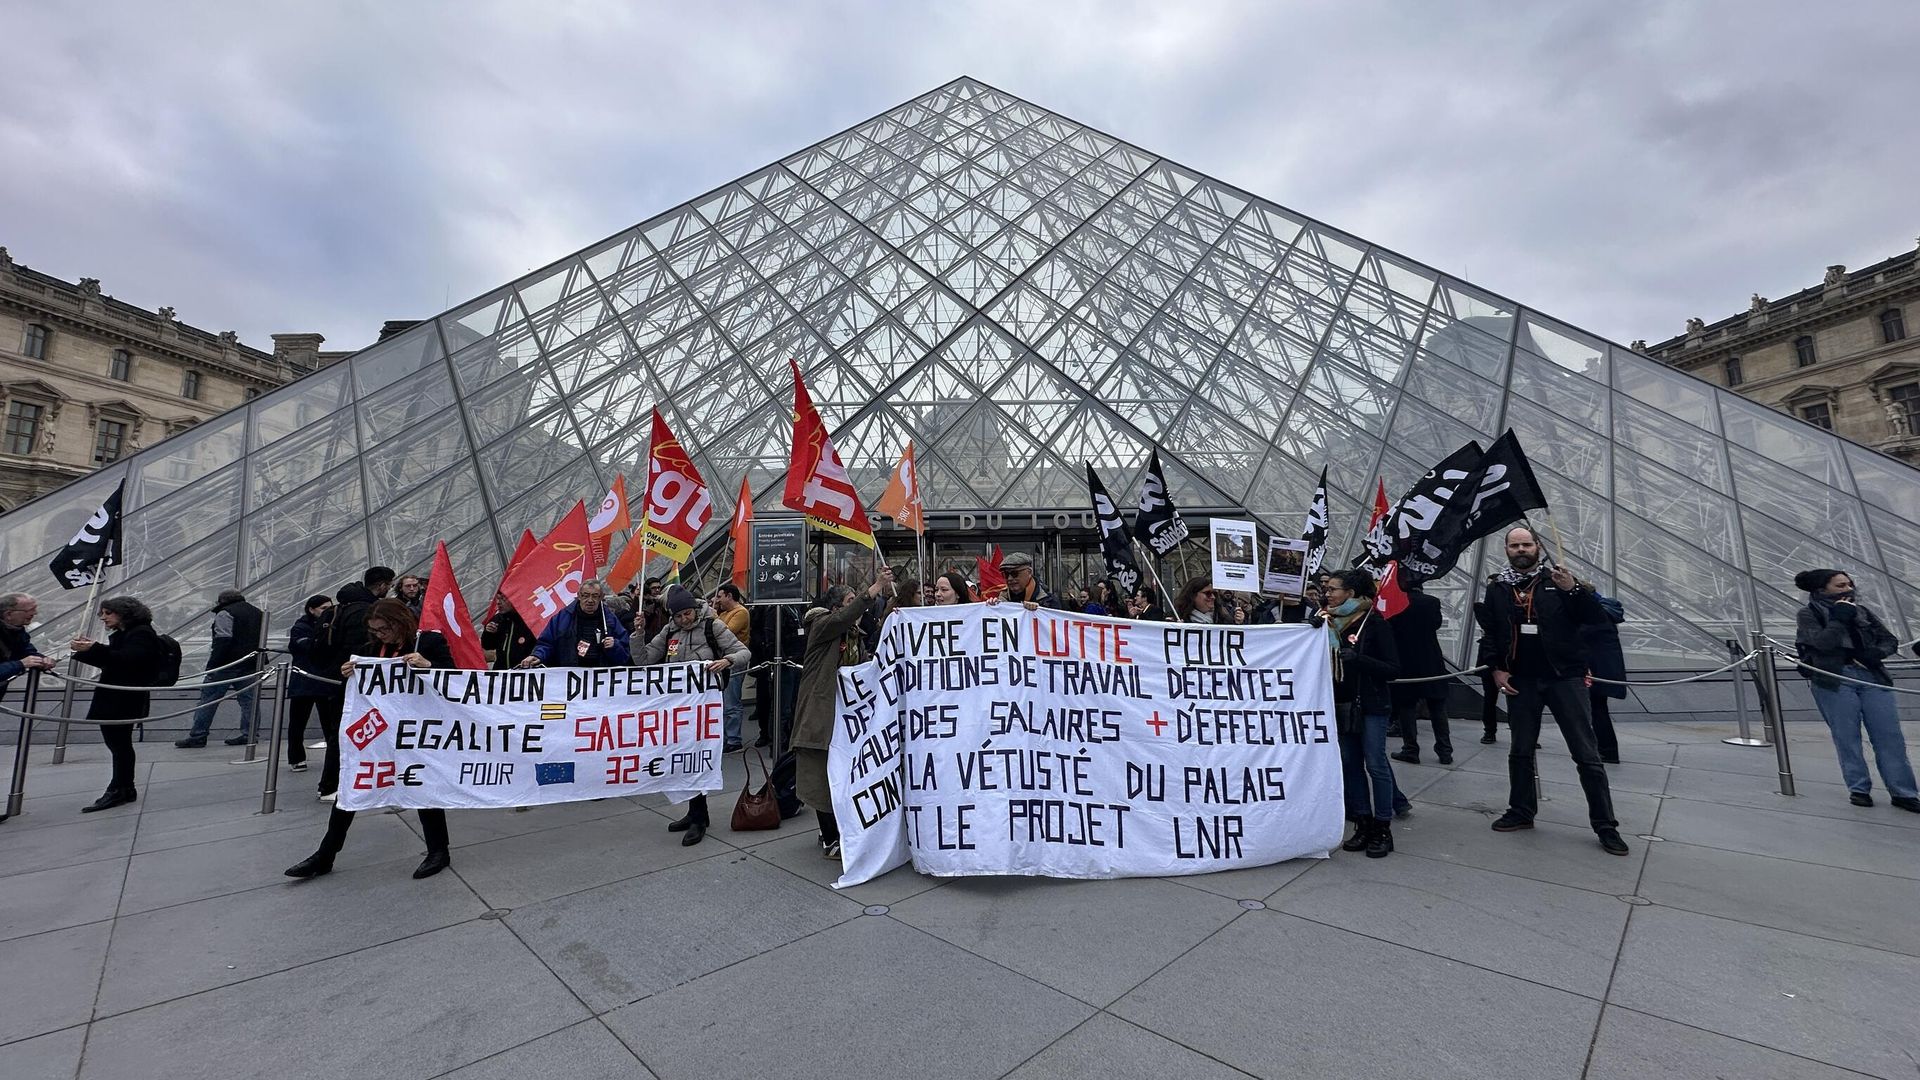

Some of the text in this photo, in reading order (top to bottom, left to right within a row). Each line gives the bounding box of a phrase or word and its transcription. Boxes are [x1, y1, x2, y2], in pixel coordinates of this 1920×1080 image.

[959, 513, 1098, 531] DU LOU
[838, 670, 873, 708] LE
[982, 617, 1019, 653] EN
[1032, 617, 1132, 664] LUTTE
[1163, 628, 1247, 666] POUR
[1008, 655, 1038, 688] DE
[1043, 659, 1152, 700] TRAVAIL
[395, 703, 722, 753] EGALITE SACRIFIE
[910, 705, 959, 741] DES
[990, 701, 1122, 744] SALAIRES
[1176, 702, 1329, 745] D'EFFECTIFS
[459, 763, 514, 786] POUR
[671, 749, 713, 775] POUR
[908, 753, 937, 791] LA
[957, 738, 1094, 796] VÉTUSTÉ
[1126, 760, 1165, 802] DU
[1184, 766, 1286, 804] PALAIS
[937, 805, 976, 850] LE
[1008, 799, 1130, 849] PROJET
[1173, 815, 1243, 859] LNR
